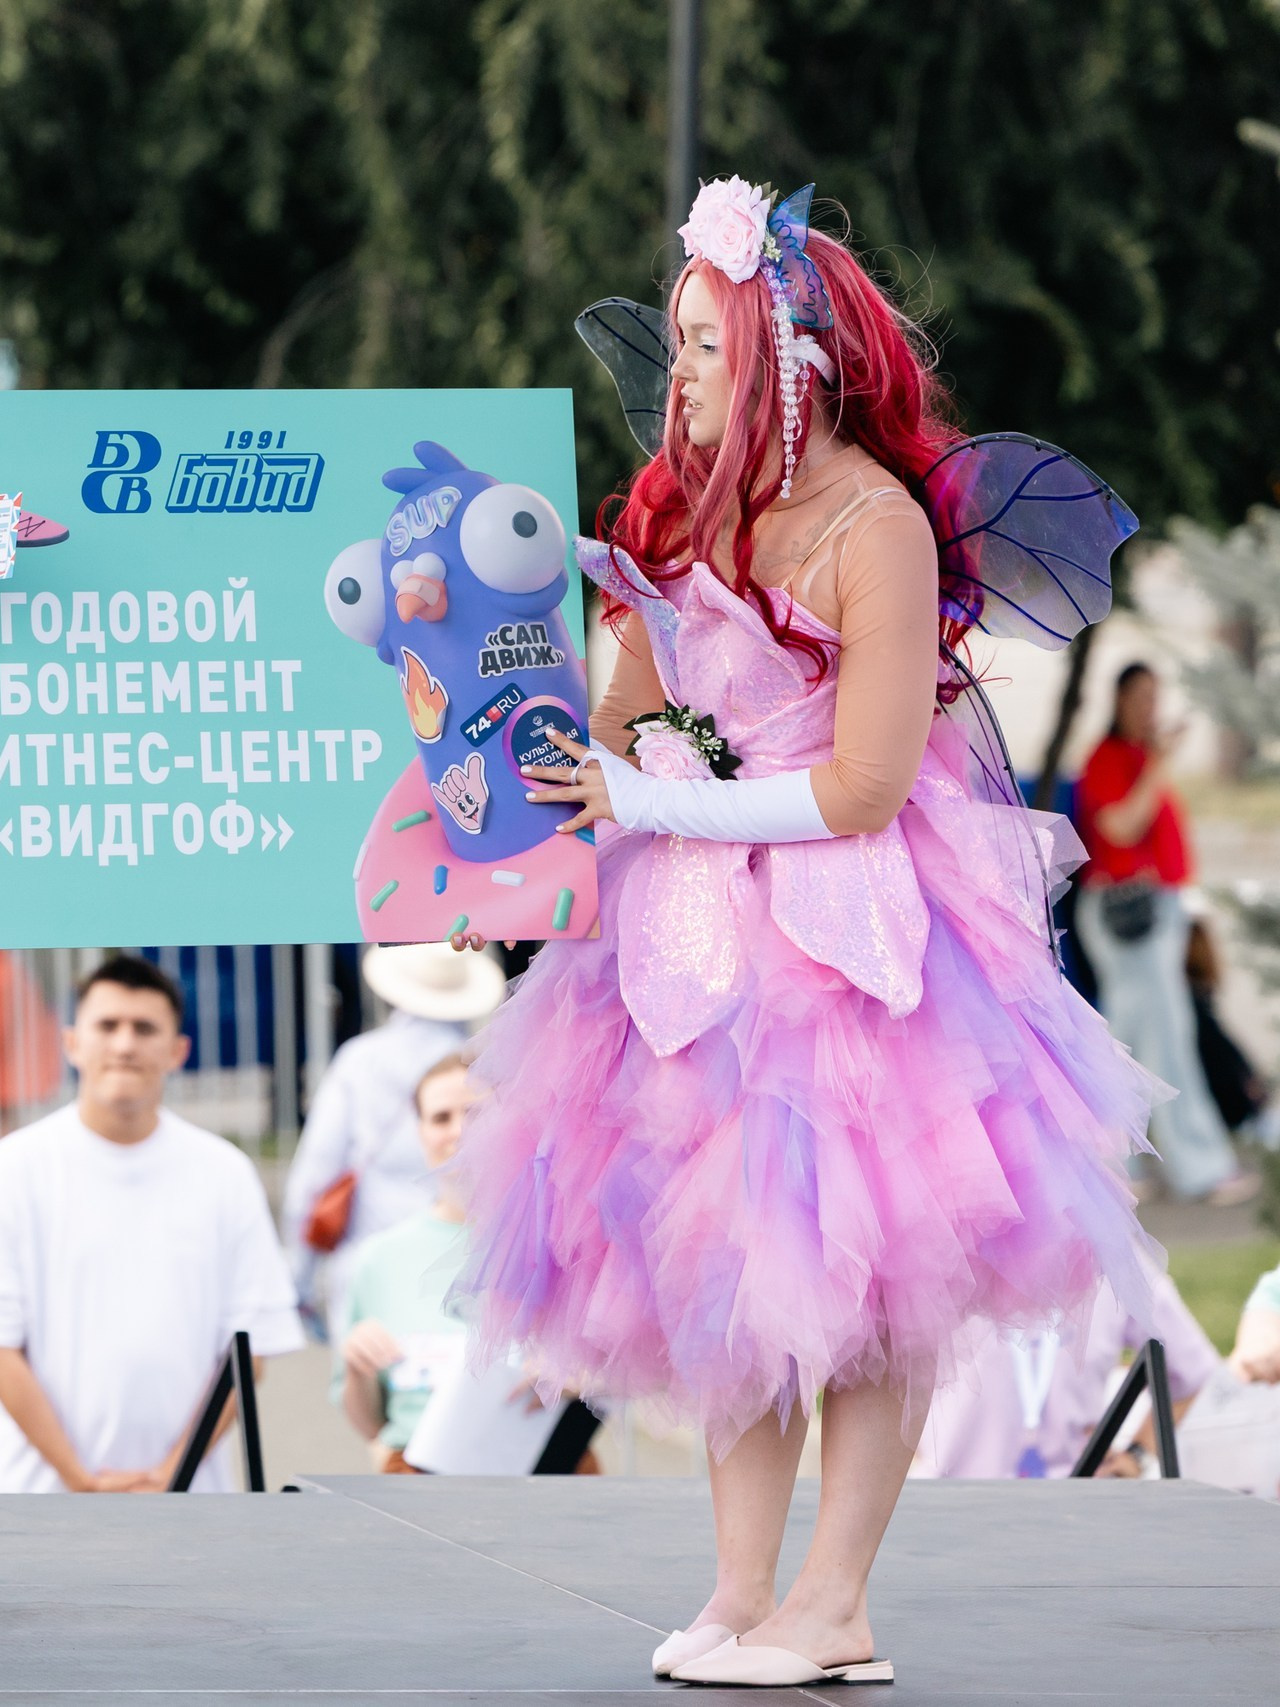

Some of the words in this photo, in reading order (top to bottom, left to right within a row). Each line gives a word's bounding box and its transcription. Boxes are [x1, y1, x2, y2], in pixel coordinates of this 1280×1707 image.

[224, 430, 287, 449] 1991
[387, 486, 463, 557] SUP
[0, 577, 257, 653] ГОДОВОЙ
[488, 624, 547, 646] «САП
[480, 645, 564, 676] ДВИЖ»
[519, 728, 579, 763] КУЛЬТУАЯ
[532, 749, 566, 766] СТОЛИ
